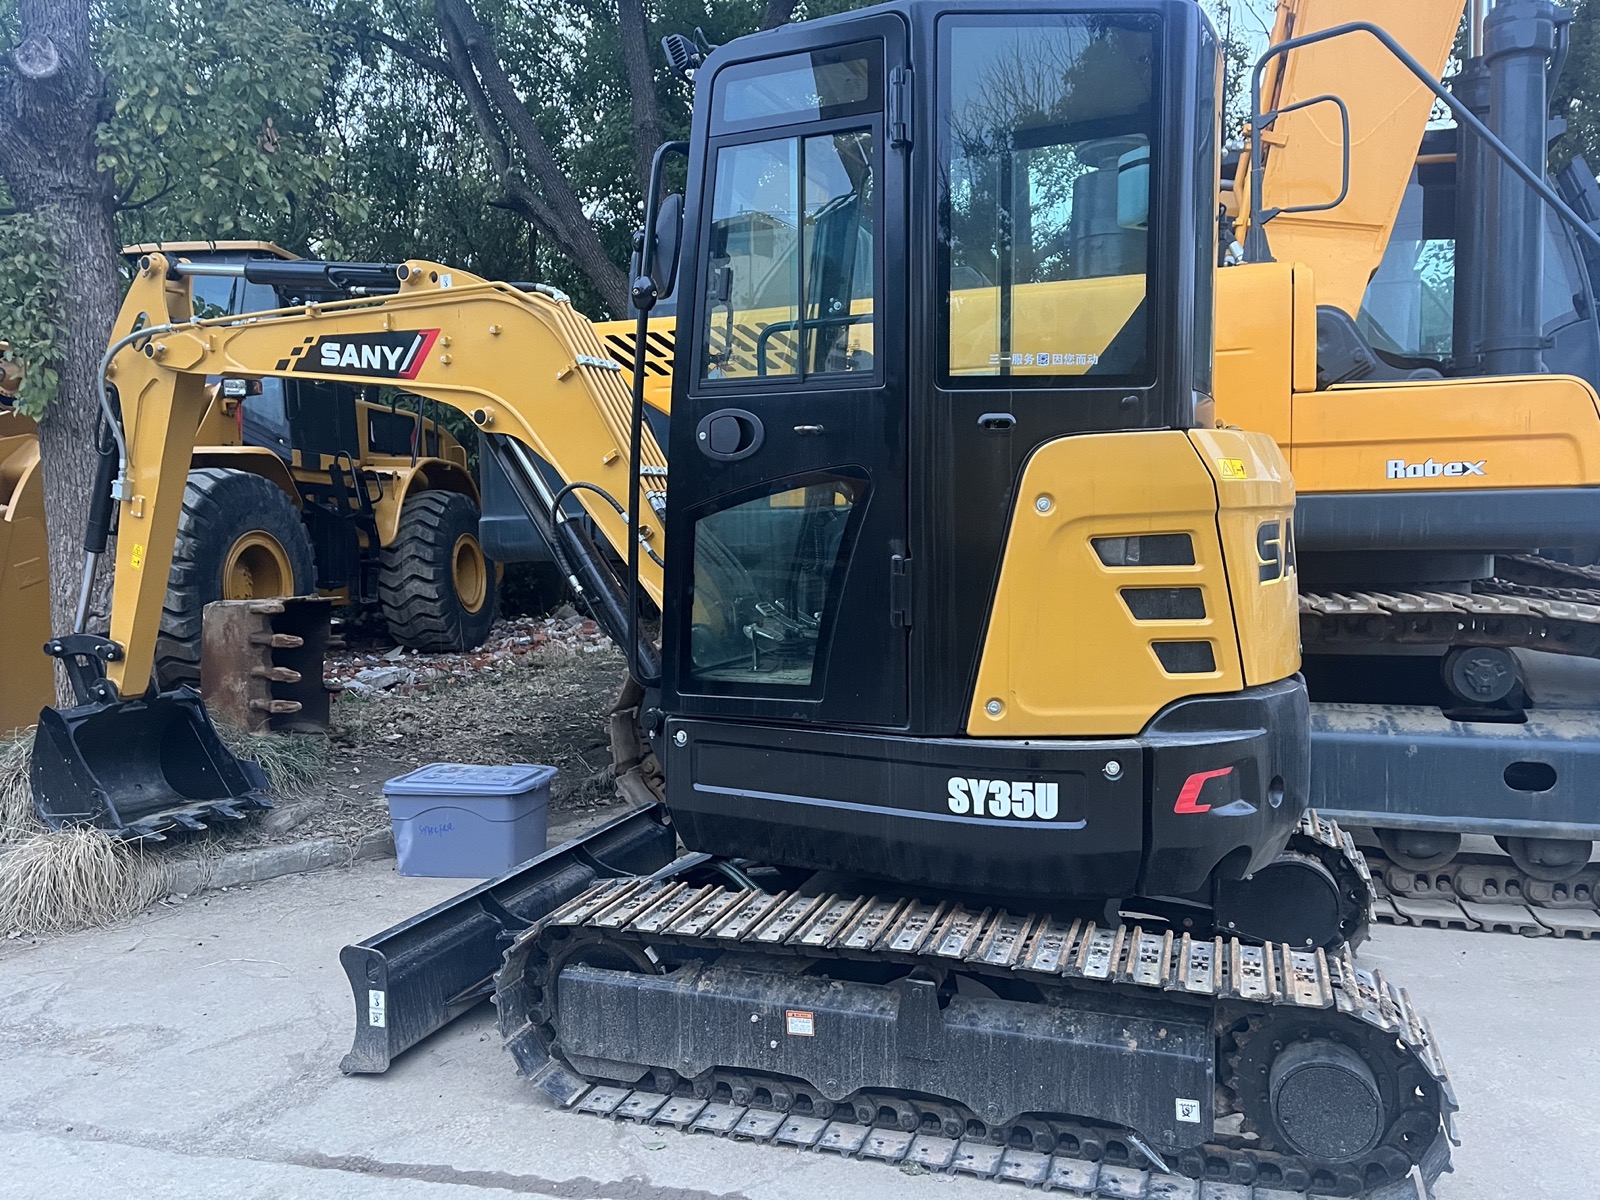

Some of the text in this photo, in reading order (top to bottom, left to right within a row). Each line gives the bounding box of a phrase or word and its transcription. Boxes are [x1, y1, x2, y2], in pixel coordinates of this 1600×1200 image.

[320, 342, 404, 371] SANY
[988, 353, 1099, 365] 三一服务 因您而动
[1386, 458, 1487, 479] Robex
[947, 776, 1059, 819] SY35U
